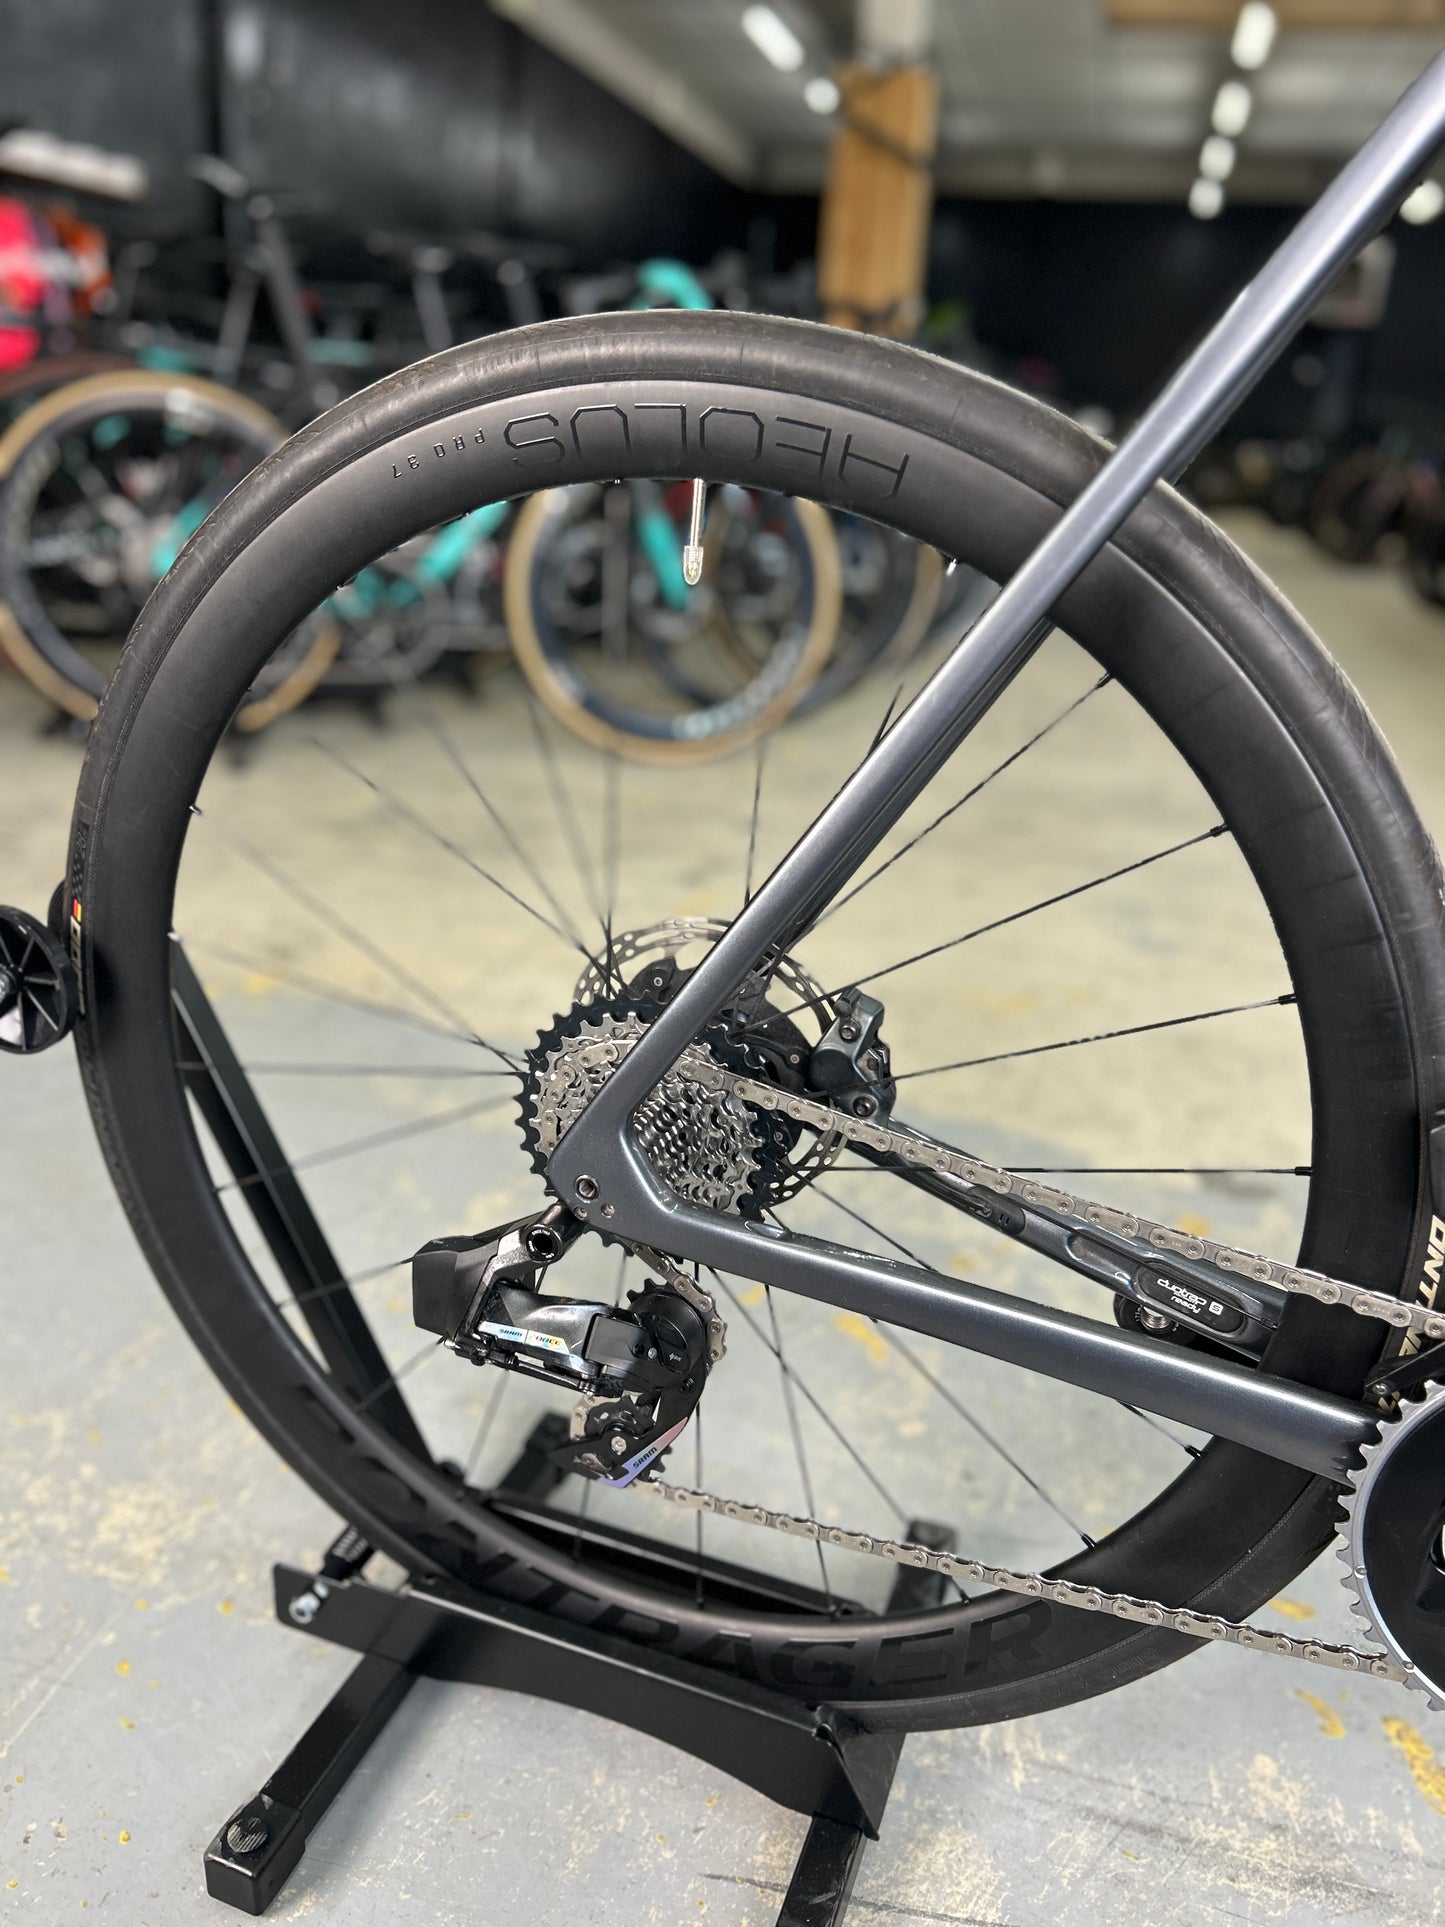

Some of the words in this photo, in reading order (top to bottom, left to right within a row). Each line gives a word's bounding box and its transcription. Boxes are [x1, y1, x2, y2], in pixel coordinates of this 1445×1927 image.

[432, 427, 486, 459] PRO
[503, 402, 910, 499] AEOLUS
[391, 454, 420, 480] 37
[632, 1446, 658, 1469] SRAM
